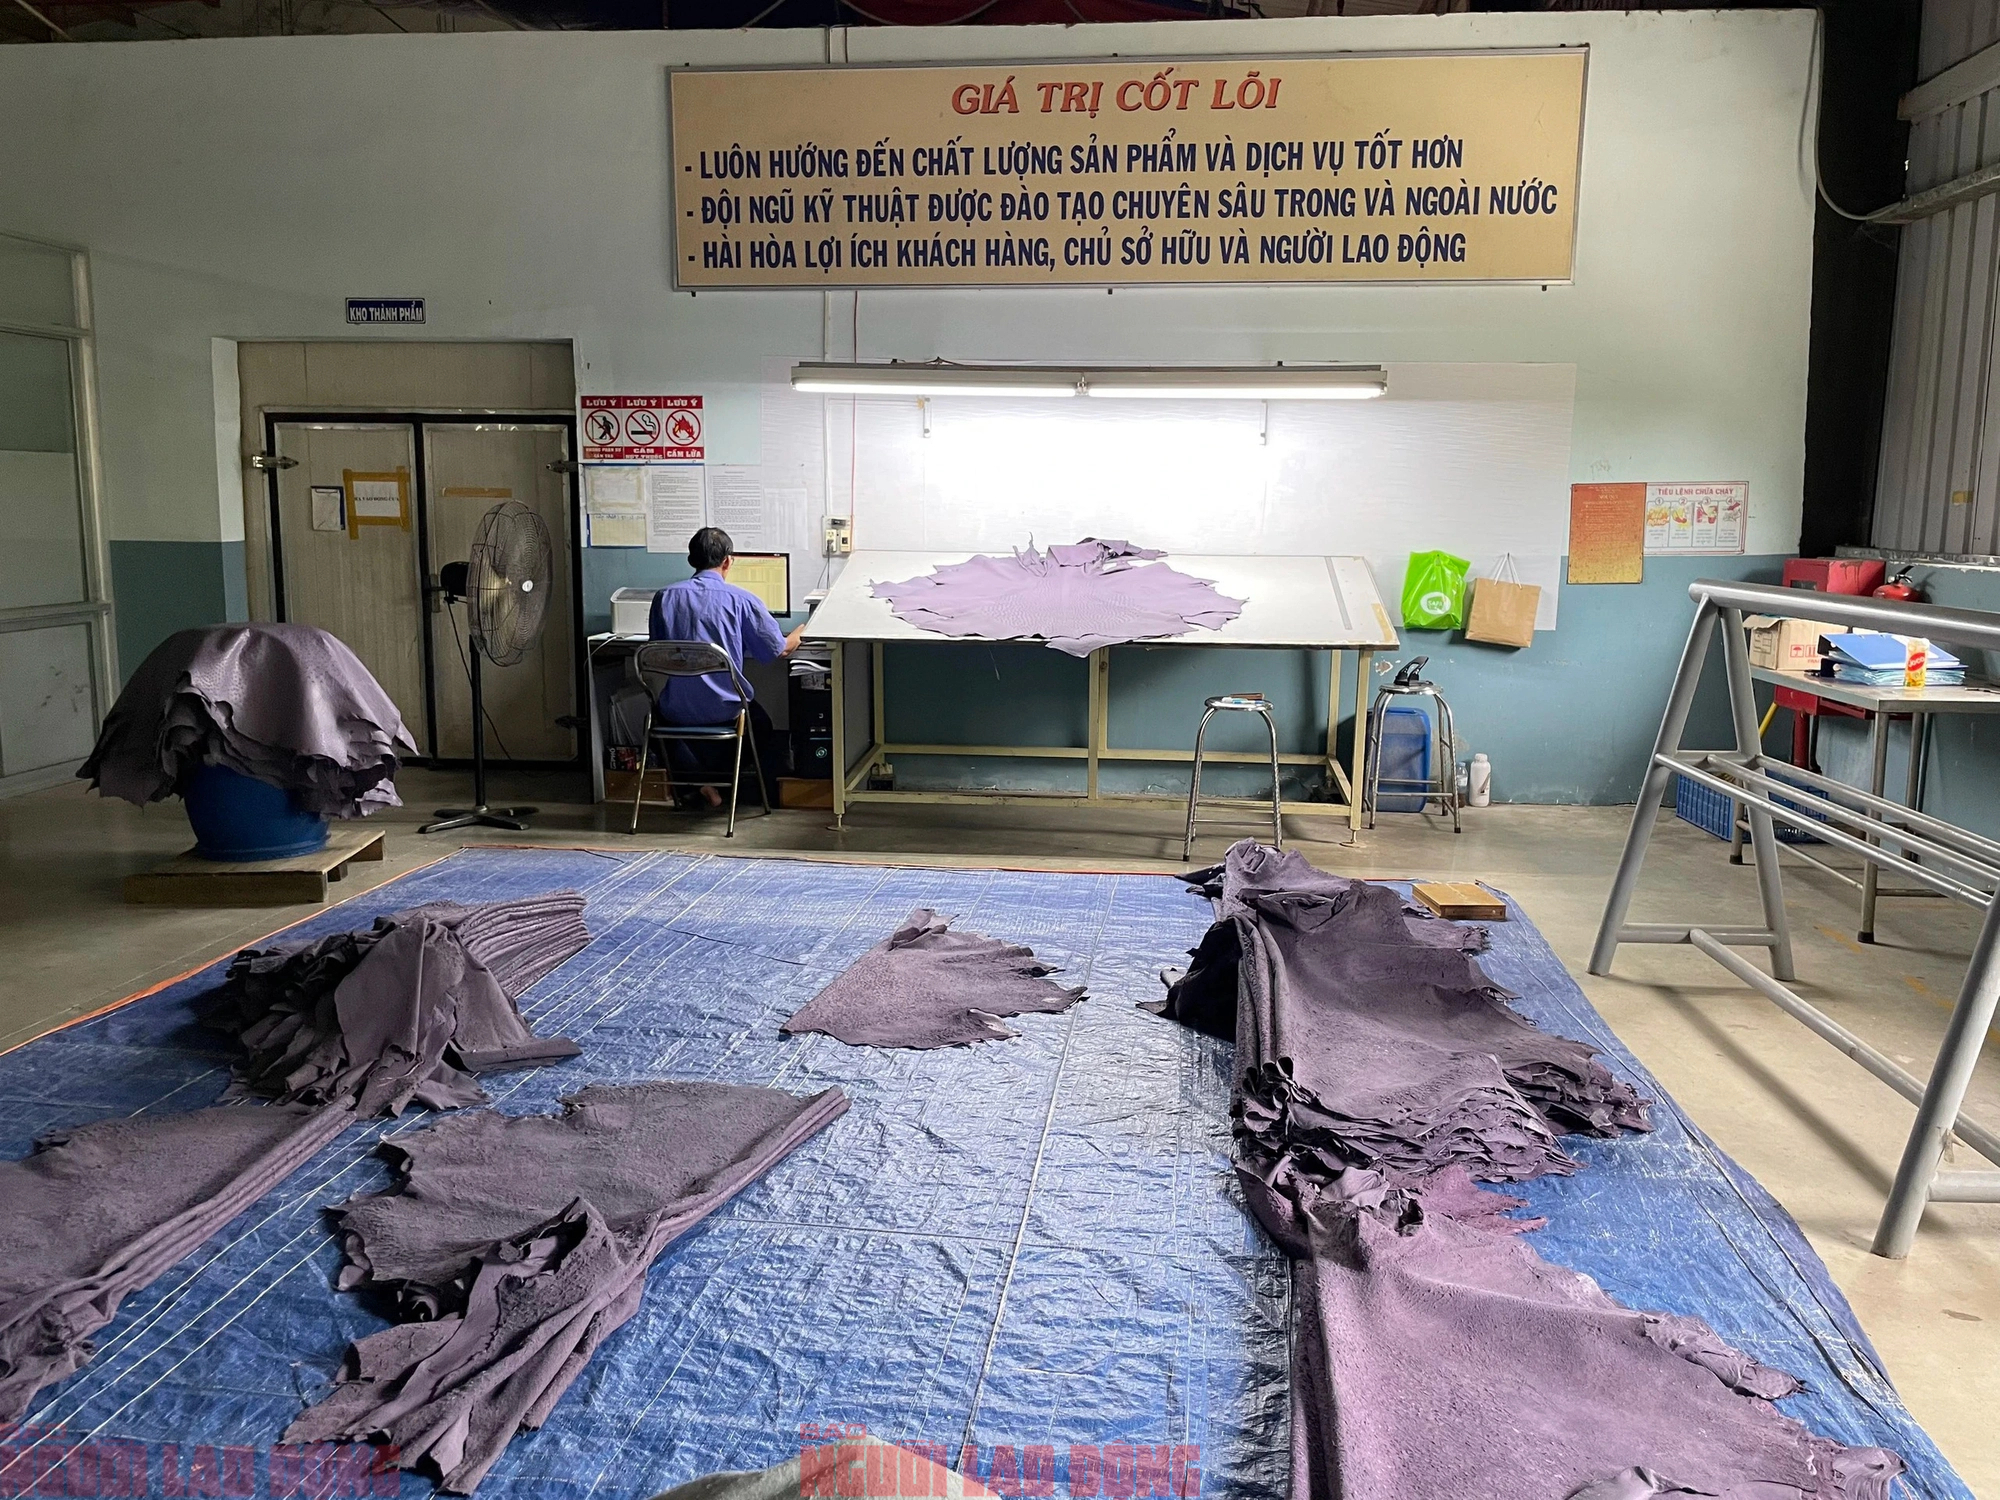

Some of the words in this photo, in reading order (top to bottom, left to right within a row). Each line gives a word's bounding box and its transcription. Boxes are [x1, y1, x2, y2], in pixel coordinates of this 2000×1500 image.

[951, 75, 1019, 115] GIÁ
[1037, 81, 1104, 119] TRỊ
[1116, 67, 1199, 112] CỐT
[1210, 71, 1283, 110] LÕI
[700, 142, 761, 179] LUÔN
[770, 140, 848, 178] HƯỚNG
[856, 137, 905, 177] ĐẾN
[912, 136, 975, 176] CHẤT
[984, 140, 1063, 181] LƯỢNG
[1070, 133, 1118, 175] SẢN
[1126, 128, 1197, 173] PHẨM
[1205, 135, 1236, 172] VÀ
[1246, 141, 1304, 178] DỊCH
[1313, 140, 1345, 177] VỤ
[1354, 128, 1403, 170] TỐT
[1411, 135, 1464, 169] HƠN
[701, 188, 741, 230] ĐỘI
[750, 188, 794, 224] NGŨ
[804, 187, 834, 224] KỸ
[843, 186, 920, 228] THUẬT
[928, 187, 993, 228] ĐƯỢC
[1000, 185, 1050, 221] ĐÀO
[1057, 190, 1105, 226] TẠO
[1112, 182, 1210, 220] CHUYÊN
[1217, 182, 1266, 218] SÂU
[1274, 187, 1356, 218] TRONG
[1364, 178, 1395, 216] VÀ
[1405, 178, 1480, 216] NGOÀI
[1489, 176, 1558, 215] NƯỚC
[703, 234, 742, 269] HÀI
[750, 233, 797, 268] HÒA
[805, 235, 842, 274] LỢI
[850, 232, 888, 267] ÍCH
[897, 231, 976, 267] KHÁCH
[985, 231, 1055, 272] HÀNG,
[1064, 226, 1112, 265] CHỦ
[1121, 225, 1153, 266] SỞ
[1161, 229, 1210, 265] HỮU
[1219, 227, 1250, 265] VÀ
[1260, 226, 1334, 265] NGƯỜI
[1342, 233, 1389, 264] LAO
[1397, 226, 1466, 269] ĐỘNG
[349, 307, 367, 321] KHO
[369, 303, 398, 321] THÀNH
[399, 300, 423, 321] PHẨM
[667, 448, 684, 458] CẤM
[685, 447, 702, 458] LỬA
